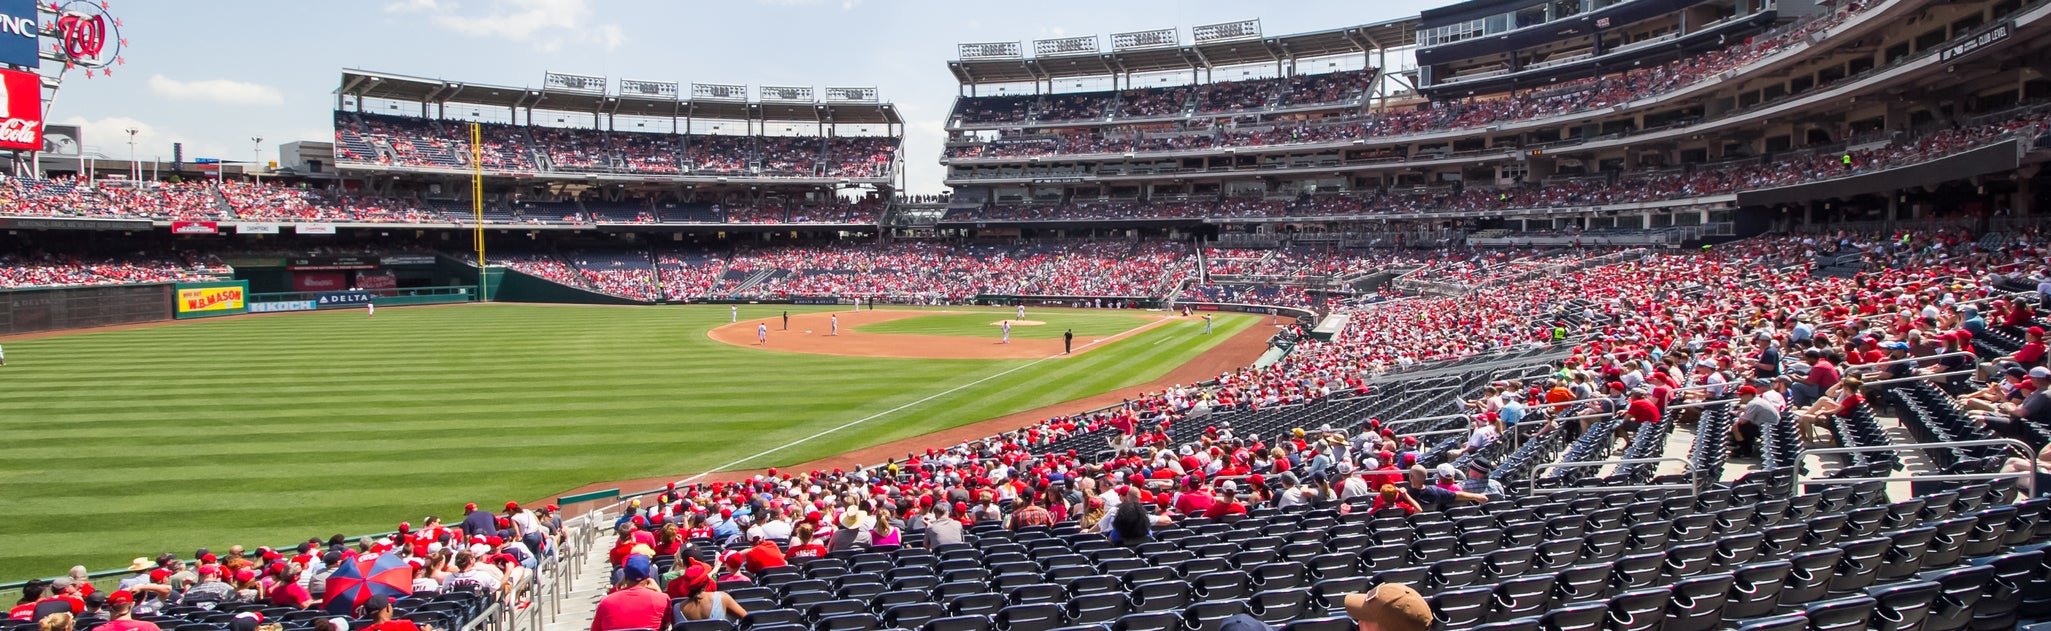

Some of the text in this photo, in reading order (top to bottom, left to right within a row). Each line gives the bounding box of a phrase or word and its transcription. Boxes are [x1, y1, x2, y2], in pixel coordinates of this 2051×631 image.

[1979, 33, 1991, 46] CLUB
[1992, 27, 2006, 40] LEVEL
[331, 294, 369, 303] DELTA
[266, 301, 308, 311] KOCH
